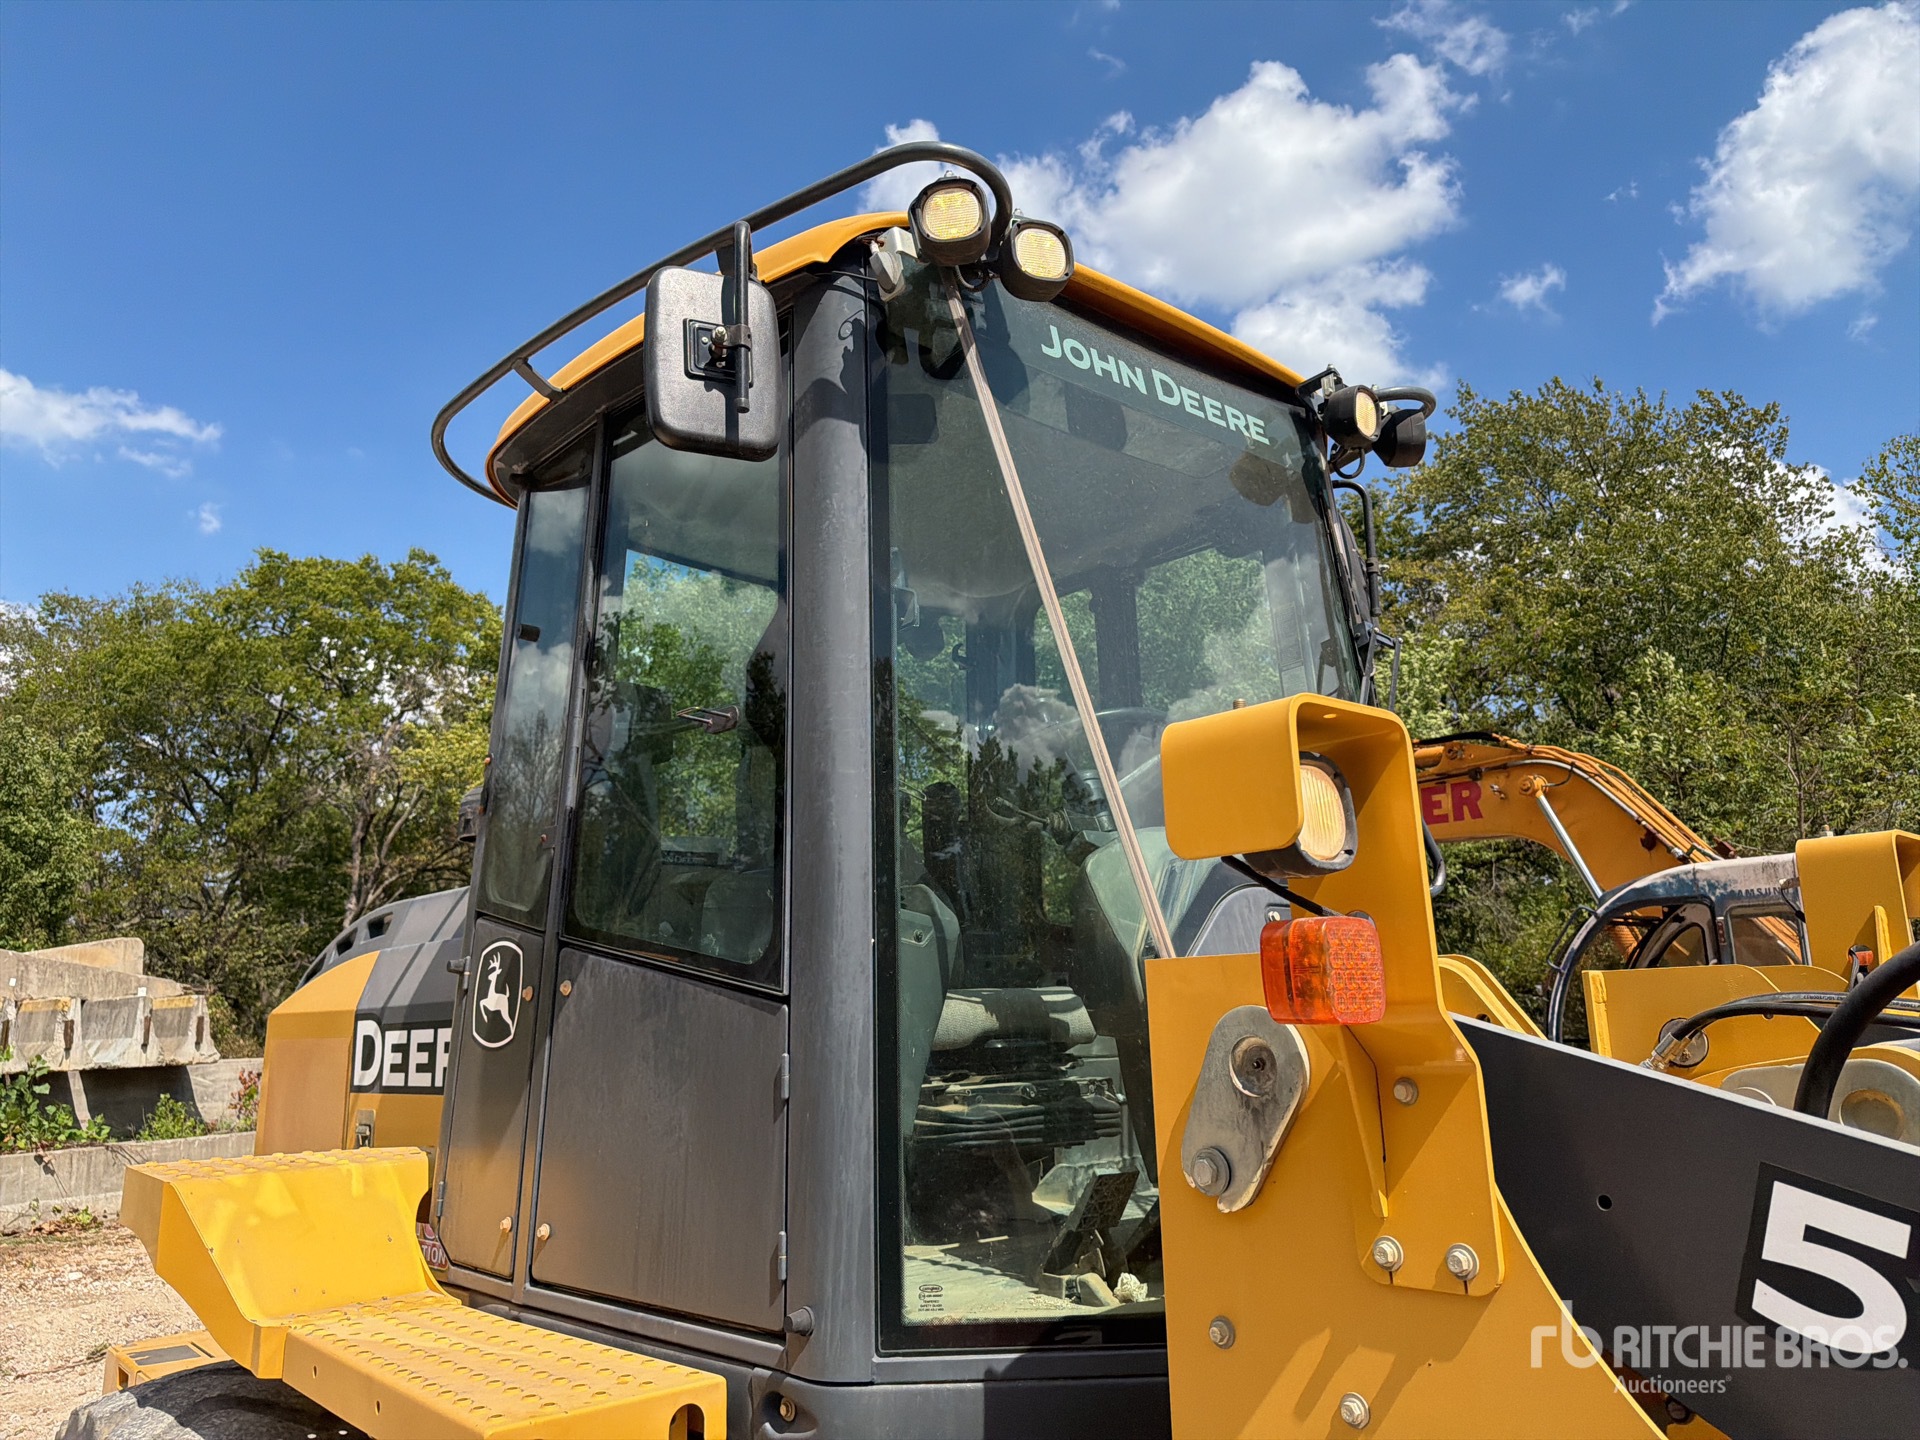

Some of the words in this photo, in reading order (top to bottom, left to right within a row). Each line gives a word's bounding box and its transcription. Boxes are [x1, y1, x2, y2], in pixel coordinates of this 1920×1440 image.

[1041, 325, 1147, 395] JOHN
[1151, 368, 1270, 445] DEERE
[1420, 781, 1483, 825] ER
[421, 1245, 447, 1265] TION
[1752, 1180, 1920, 1354] 5
